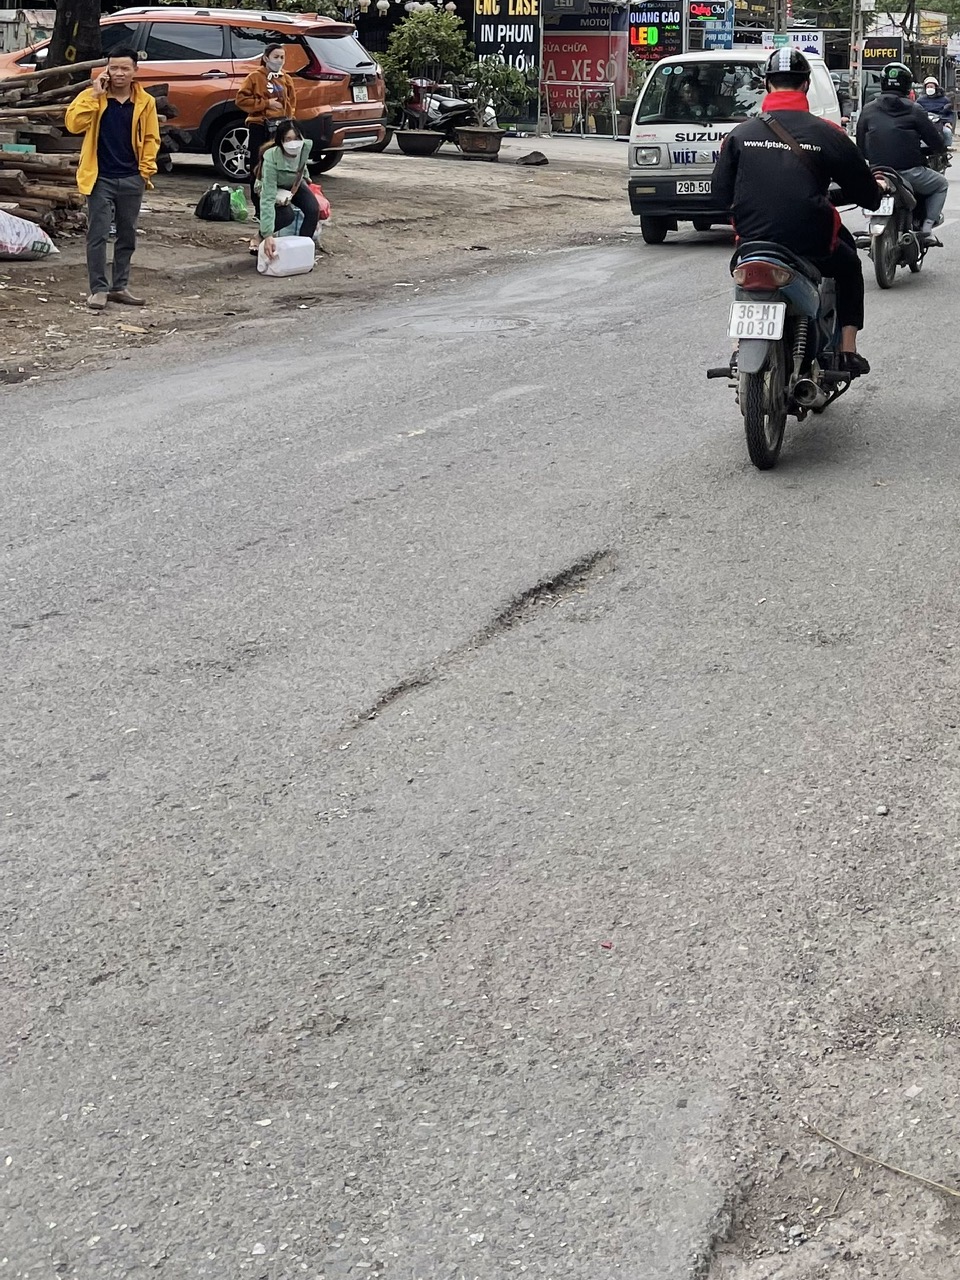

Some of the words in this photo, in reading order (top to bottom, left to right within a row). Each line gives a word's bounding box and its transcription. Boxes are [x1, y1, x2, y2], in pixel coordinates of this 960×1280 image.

[630, 8, 660, 23] QUẢNG
[661, 9, 680, 23] CÁO
[480, 24, 494, 43] IN
[497, 24, 534, 43] PHUN
[630, 26, 659, 45] LED
[801, 33, 819, 42] BÉO
[863, 48, 898, 58] BUFFET
[571, 59, 592, 81] XE
[596, 52, 618, 82] SỐ
[673, 148, 698, 166] VIỆT
[736, 320, 775, 336] 0030
